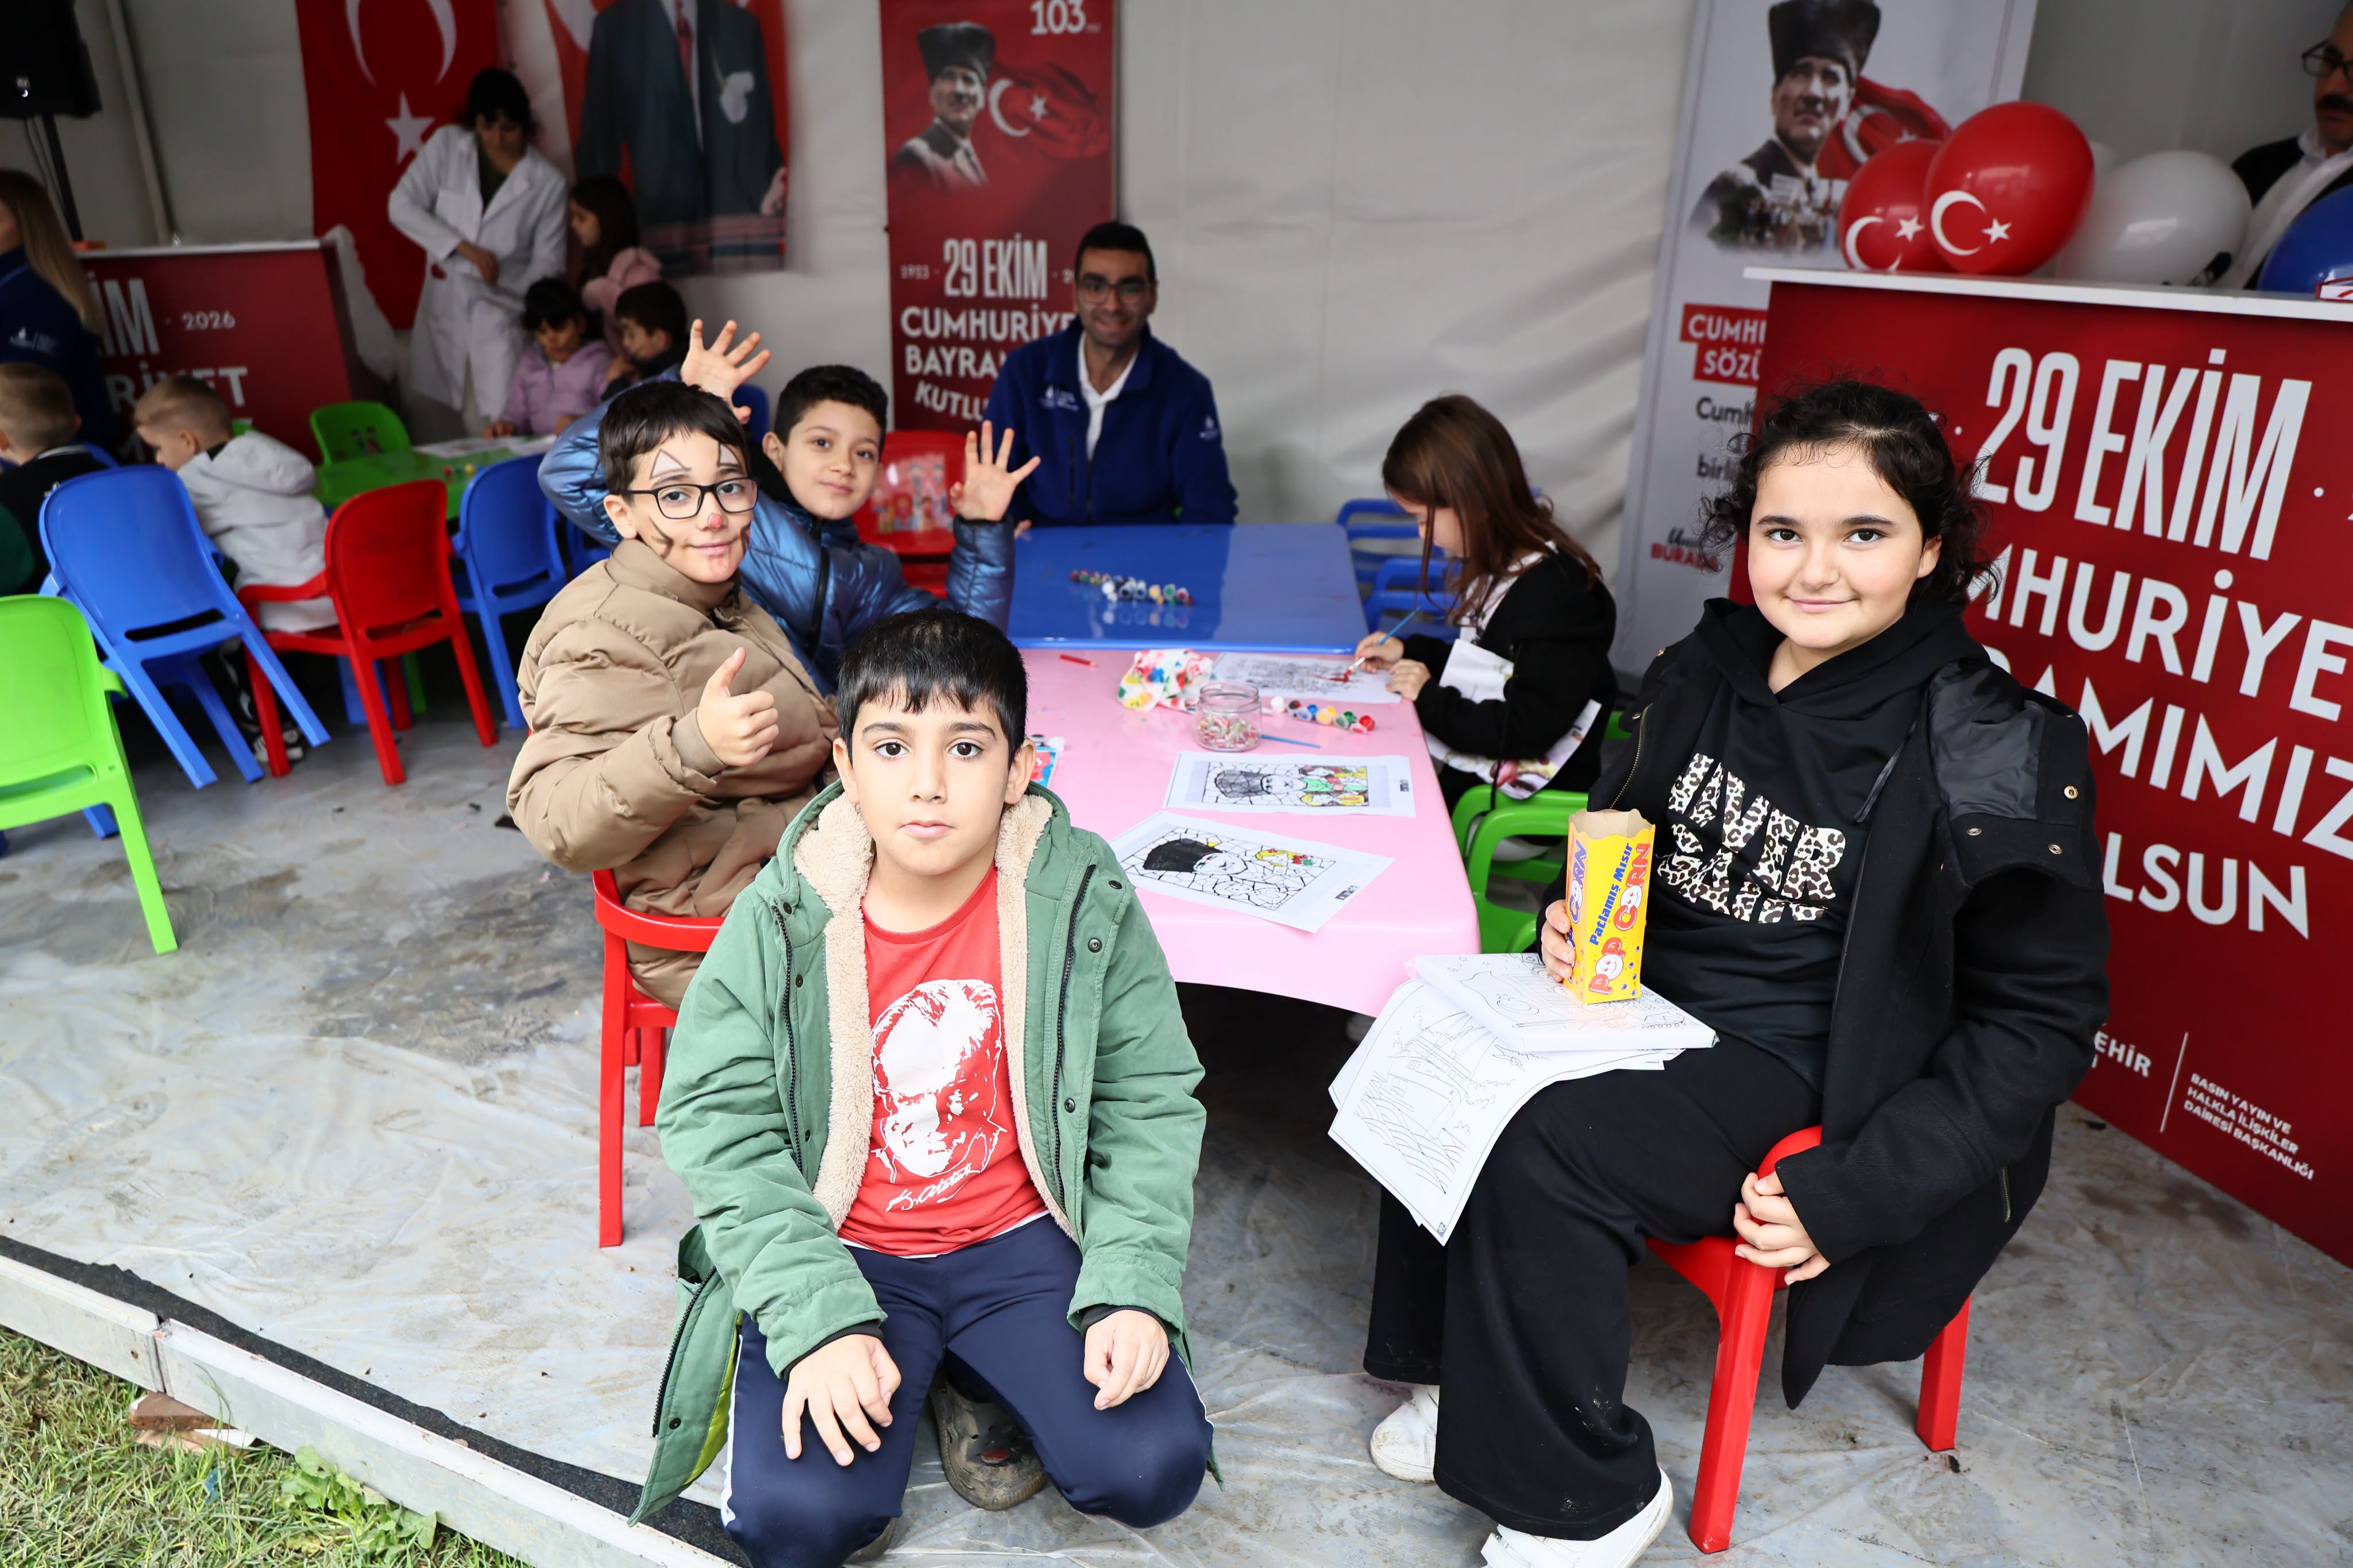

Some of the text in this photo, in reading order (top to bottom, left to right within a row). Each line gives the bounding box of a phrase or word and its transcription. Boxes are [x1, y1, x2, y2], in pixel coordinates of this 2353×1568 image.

[1030, 0, 1086, 35] 103
[943, 238, 978, 298] 29
[982, 232, 1048, 300] EKİM
[87, 271, 160, 357] İM
[182, 310, 236, 331] 2026
[905, 344, 1006, 379] BAYRA
[1969, 347, 2313, 561] 29 EKİM
[1966, 542, 2353, 722] MHURİYE
[1982, 643, 2353, 861] MIMIZ
[1588, 843, 1651, 995] POP CORN
[1589, 843, 1633, 946] Patlamış Mısır
[2103, 832, 2309, 940] LSUN
[2094, 1030, 2151, 1077] EHİR
[2184, 1099, 2314, 1180] DAİRESİ BAŞKANLIĞI
[2187, 1086, 2298, 1154] HALKLA İLİŞKİLER
[2191, 1073, 2292, 1135] BASIN YAYIN VE
